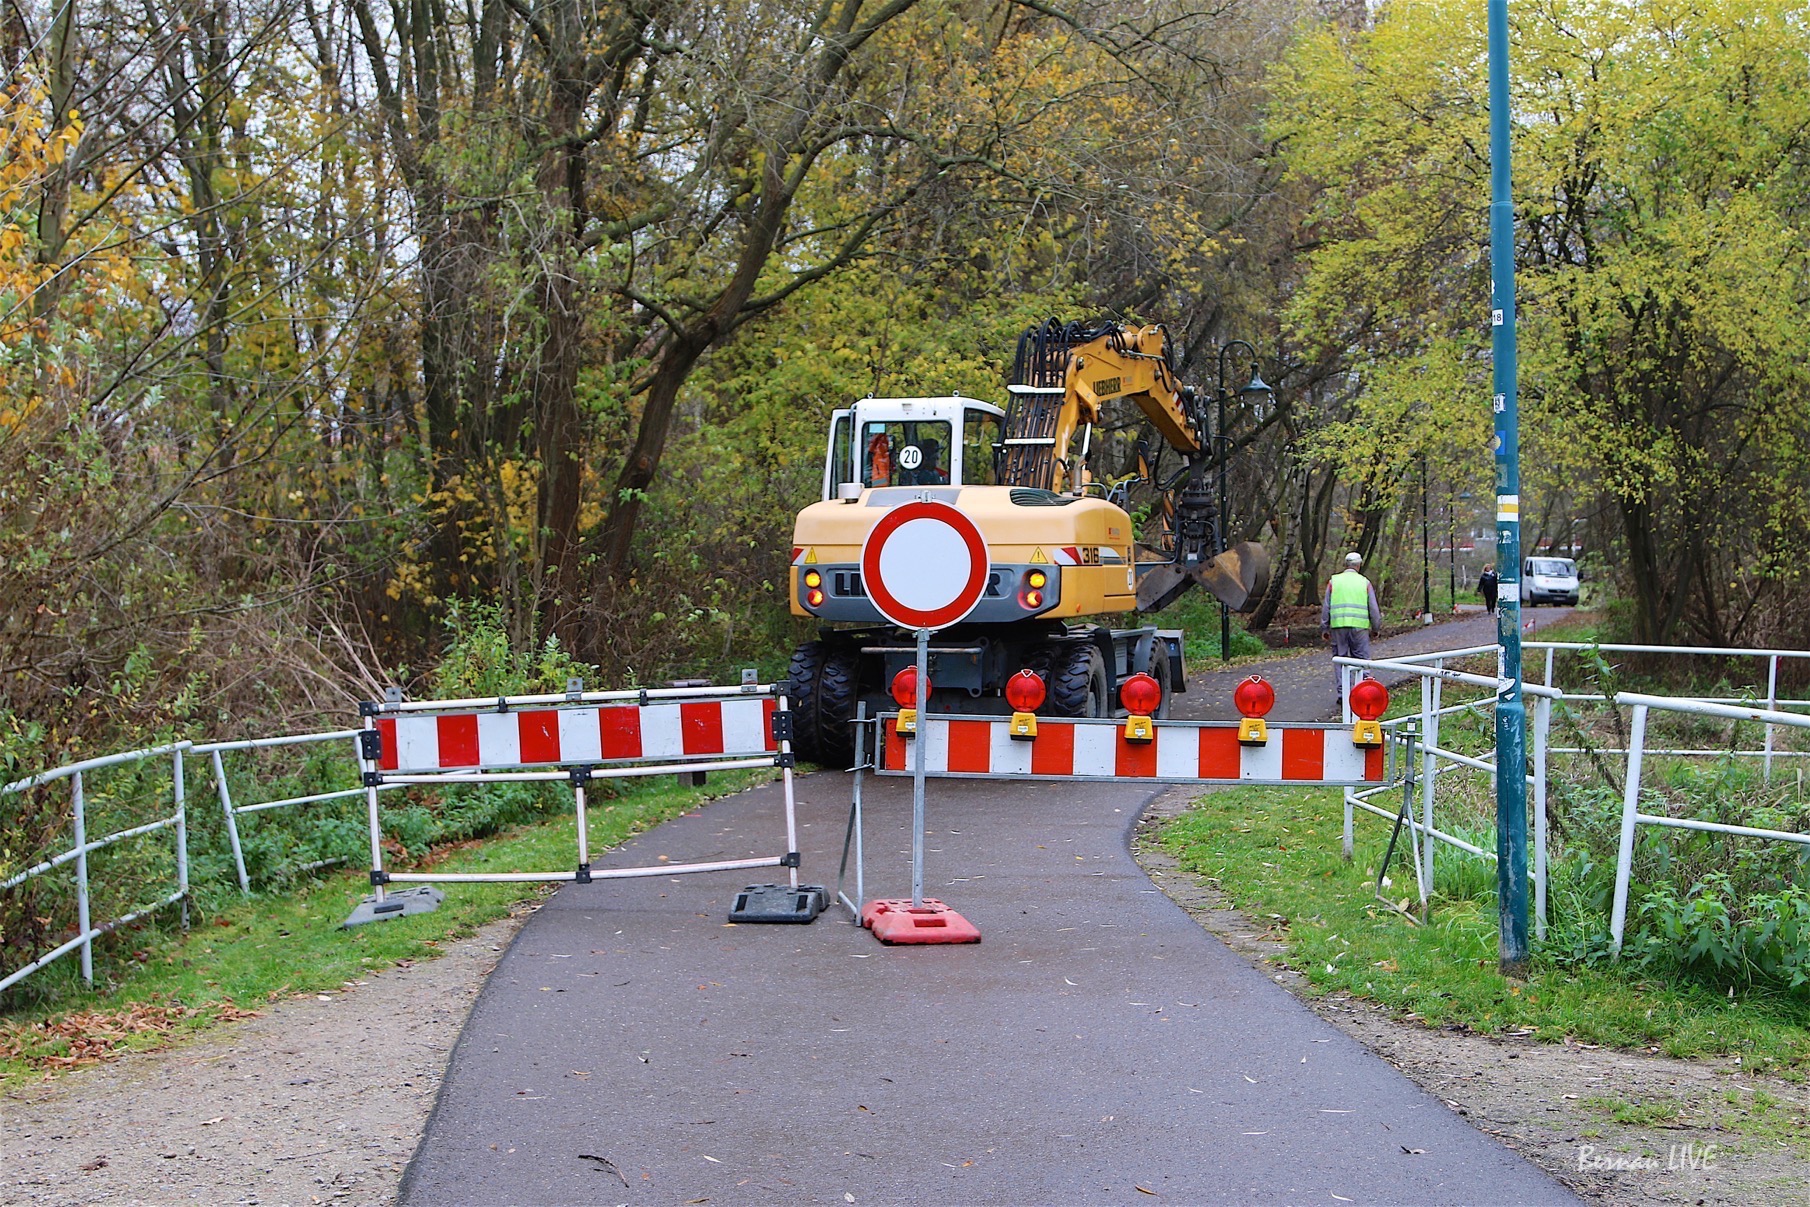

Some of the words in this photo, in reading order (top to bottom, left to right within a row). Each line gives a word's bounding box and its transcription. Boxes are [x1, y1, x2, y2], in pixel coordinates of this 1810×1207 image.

[1093, 377, 1121, 396] LIEBHERR
[904, 449, 918, 464] 20
[1082, 547, 1100, 563] 316
